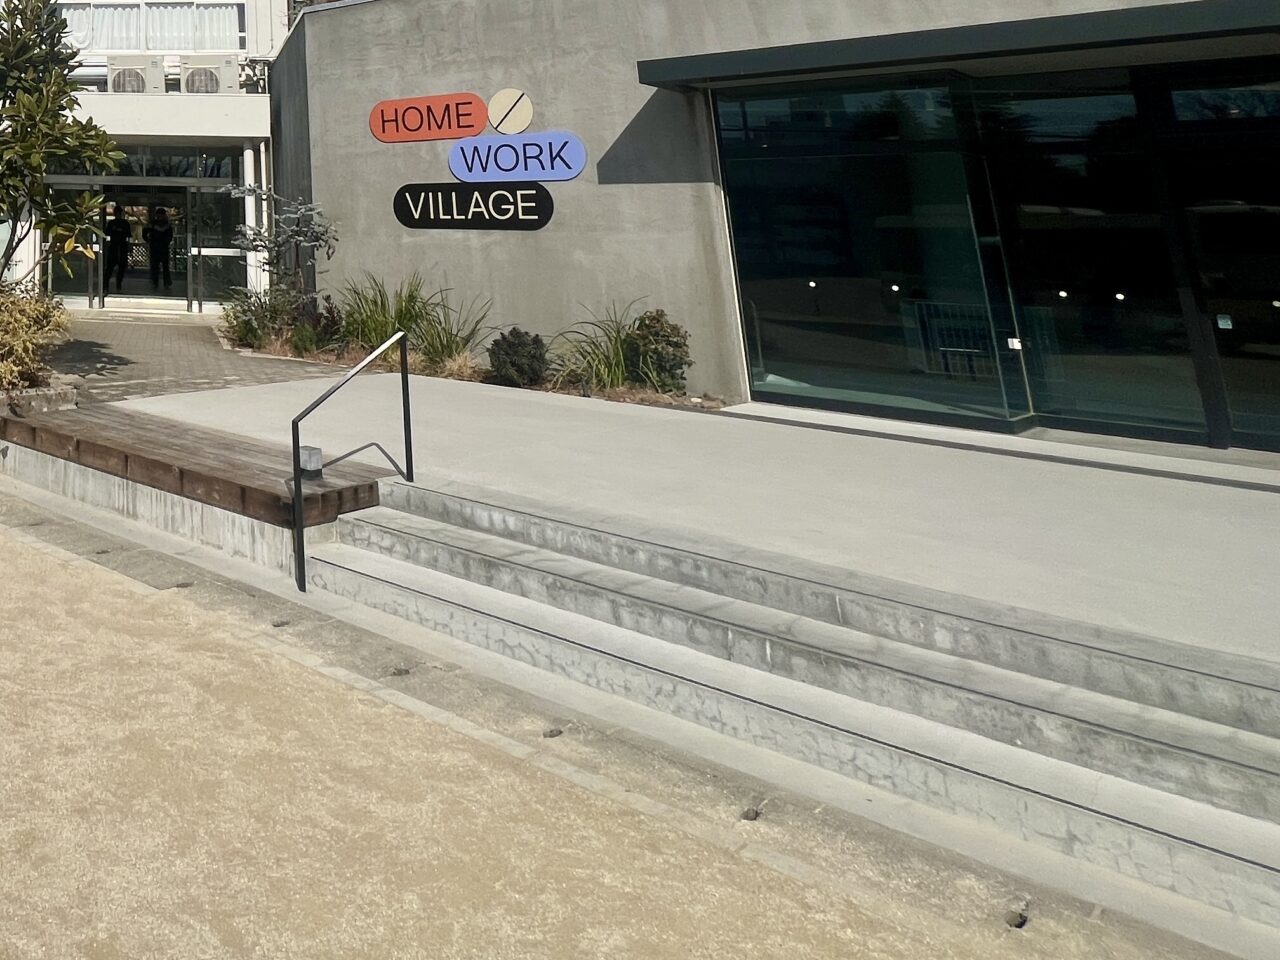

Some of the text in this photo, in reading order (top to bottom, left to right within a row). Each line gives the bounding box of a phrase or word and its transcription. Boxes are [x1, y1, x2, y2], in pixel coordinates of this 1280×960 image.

[380, 101, 475, 134] HOME
[460, 140, 573, 173] WORK
[405, 190, 539, 220] VILLAGE
